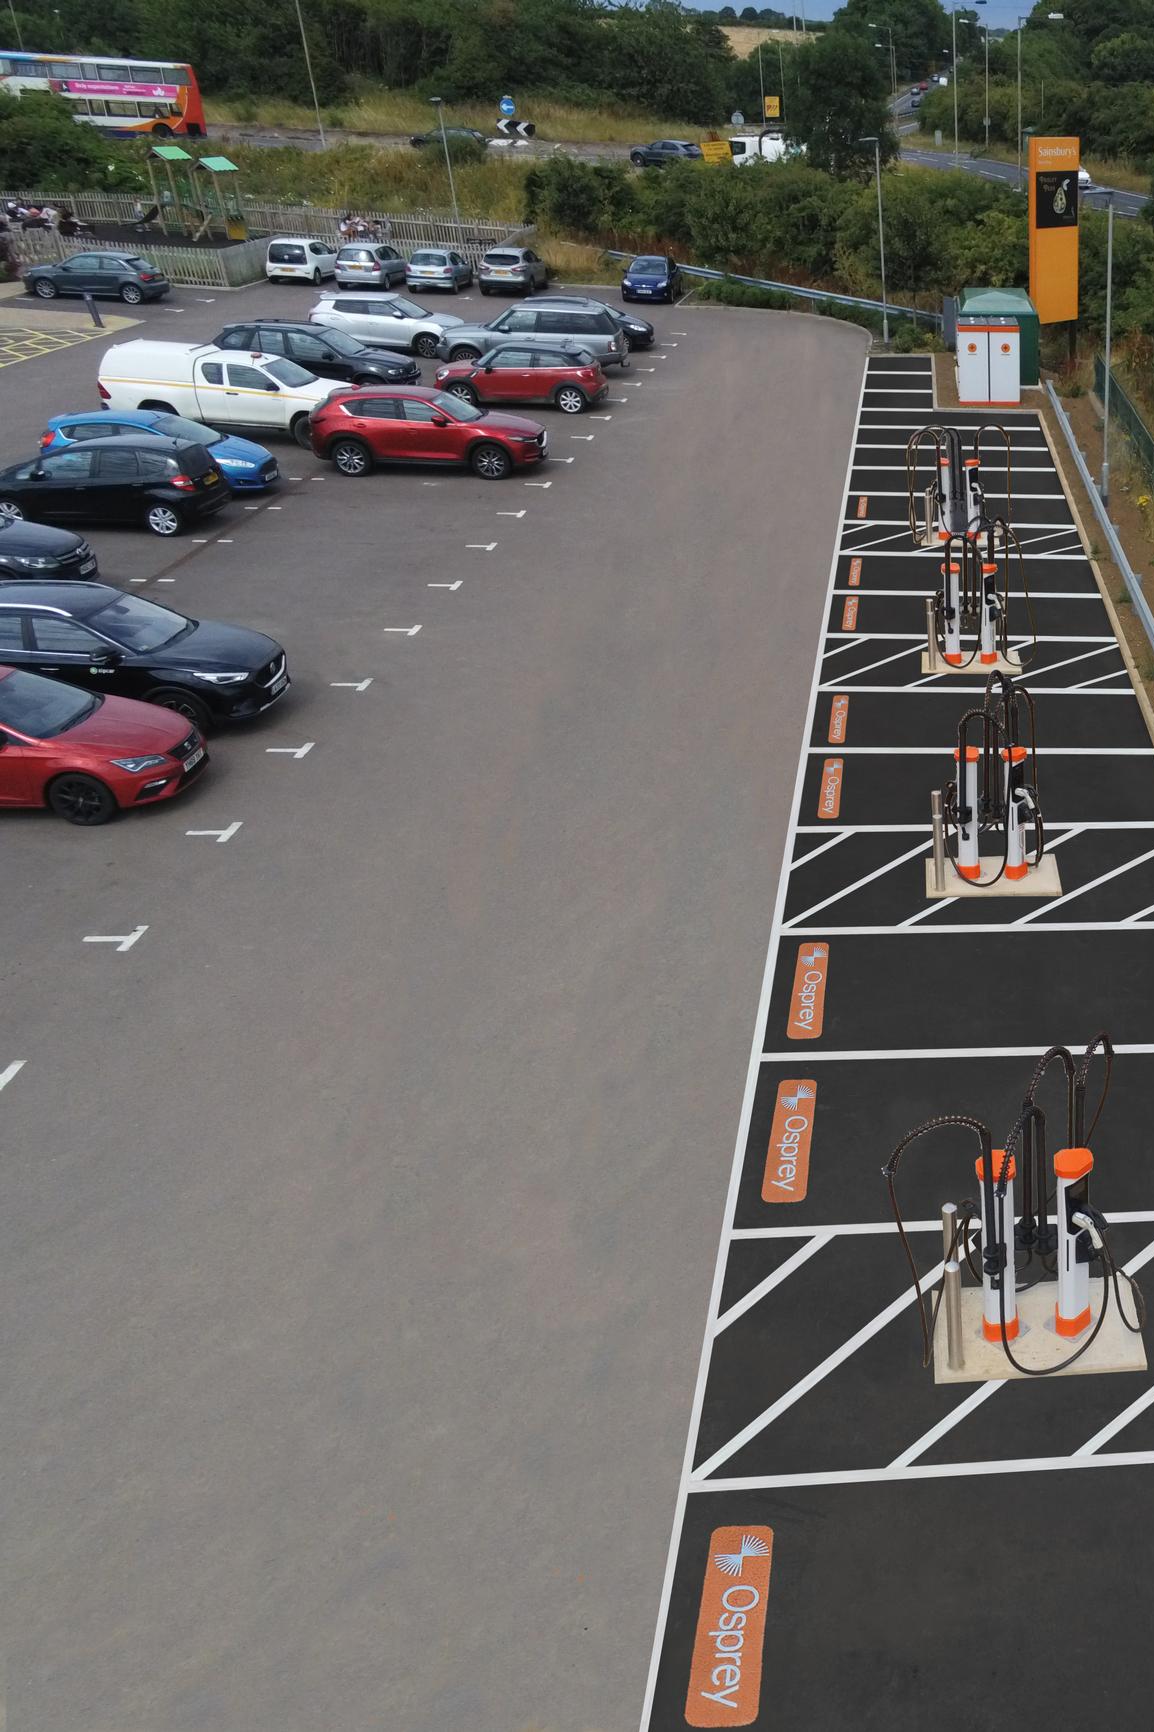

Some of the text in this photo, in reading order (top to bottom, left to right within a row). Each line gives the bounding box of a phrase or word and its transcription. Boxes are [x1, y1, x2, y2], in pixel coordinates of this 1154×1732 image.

[1038, 146, 1077, 158] Sainsbury's
[832, 710, 847, 740] Osprey
[822, 776, 840, 814] Osprey
[794, 970, 822, 1031] Osprey
[771, 1115, 808, 1191] Osprey
[701, 1584, 759, 1709] Osprey
